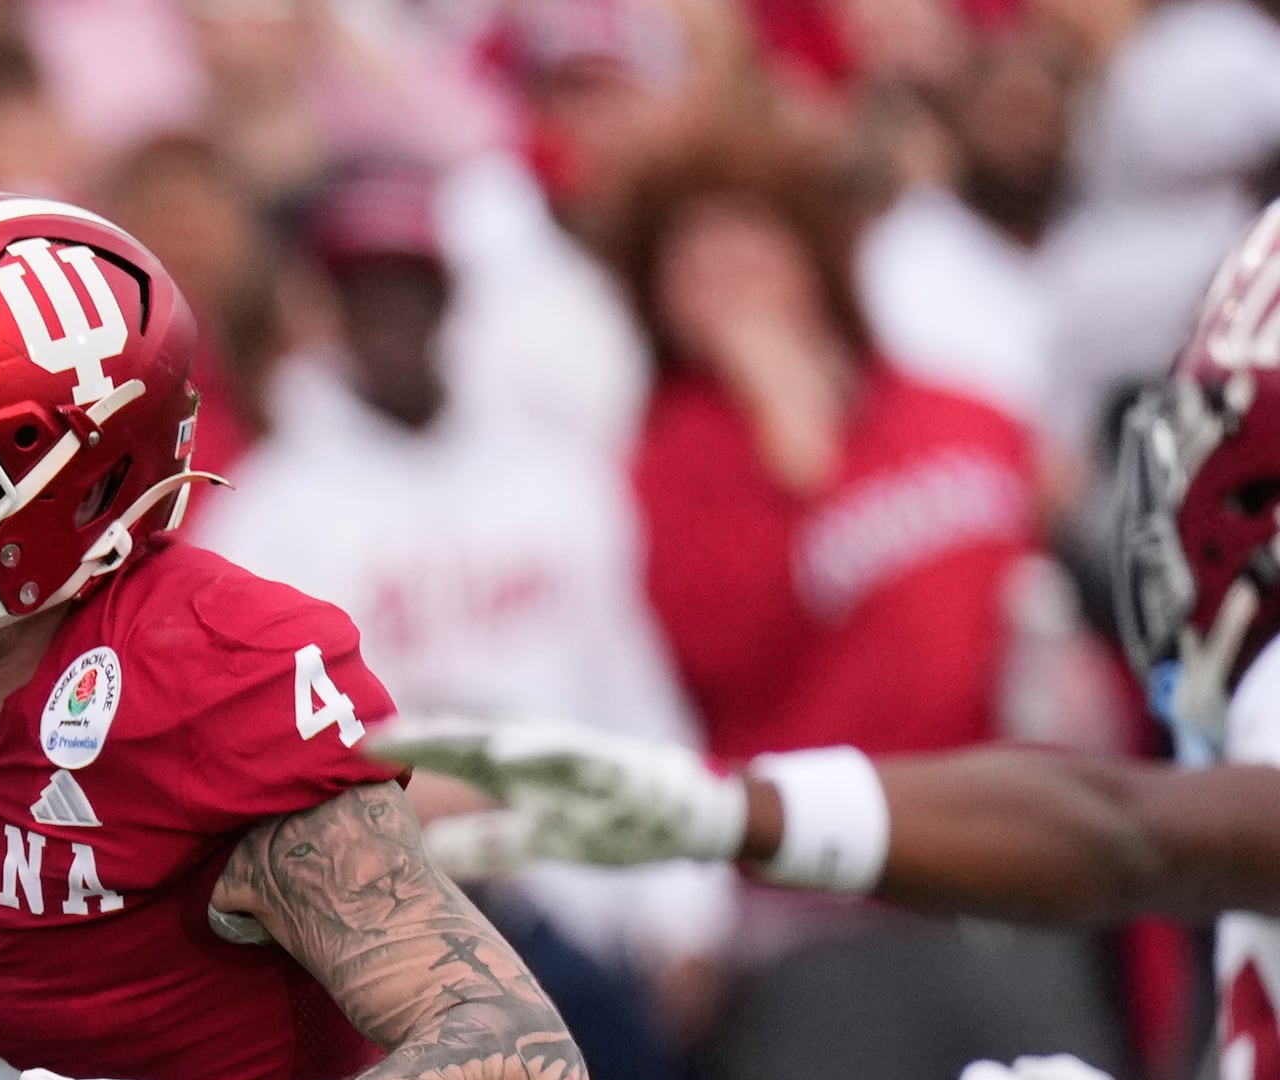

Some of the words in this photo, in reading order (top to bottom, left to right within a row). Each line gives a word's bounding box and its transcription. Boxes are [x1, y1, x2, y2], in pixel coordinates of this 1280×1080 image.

[48, 666, 78, 712] ROSE
[81, 653, 106, 669] BOWL
[103, 663, 116, 712] GAME
[294, 643, 367, 749] 4
[58, 736, 98, 750] Prudential
